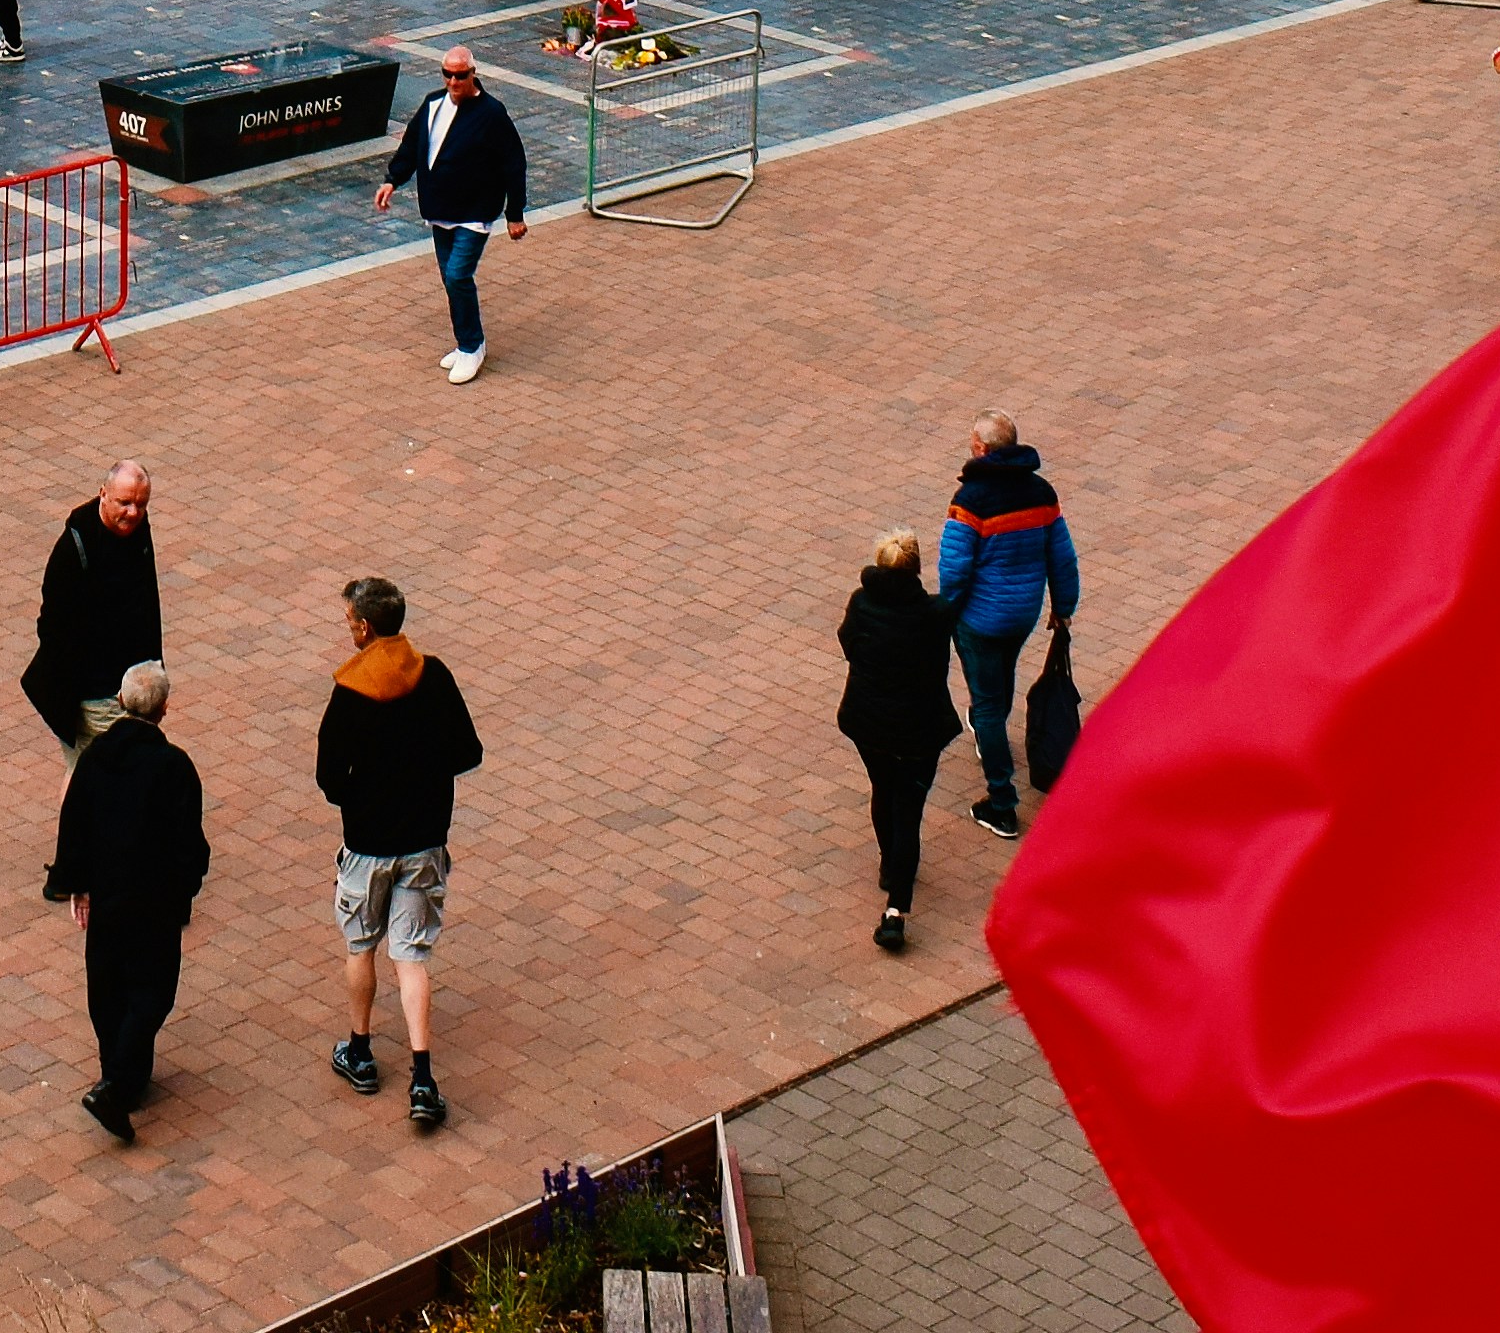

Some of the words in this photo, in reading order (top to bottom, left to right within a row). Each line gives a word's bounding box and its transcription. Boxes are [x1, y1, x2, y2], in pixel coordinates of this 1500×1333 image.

[119, 111, 147, 136] 407
[238, 108, 280, 134] JOHN
[284, 95, 343, 121] BARNES
